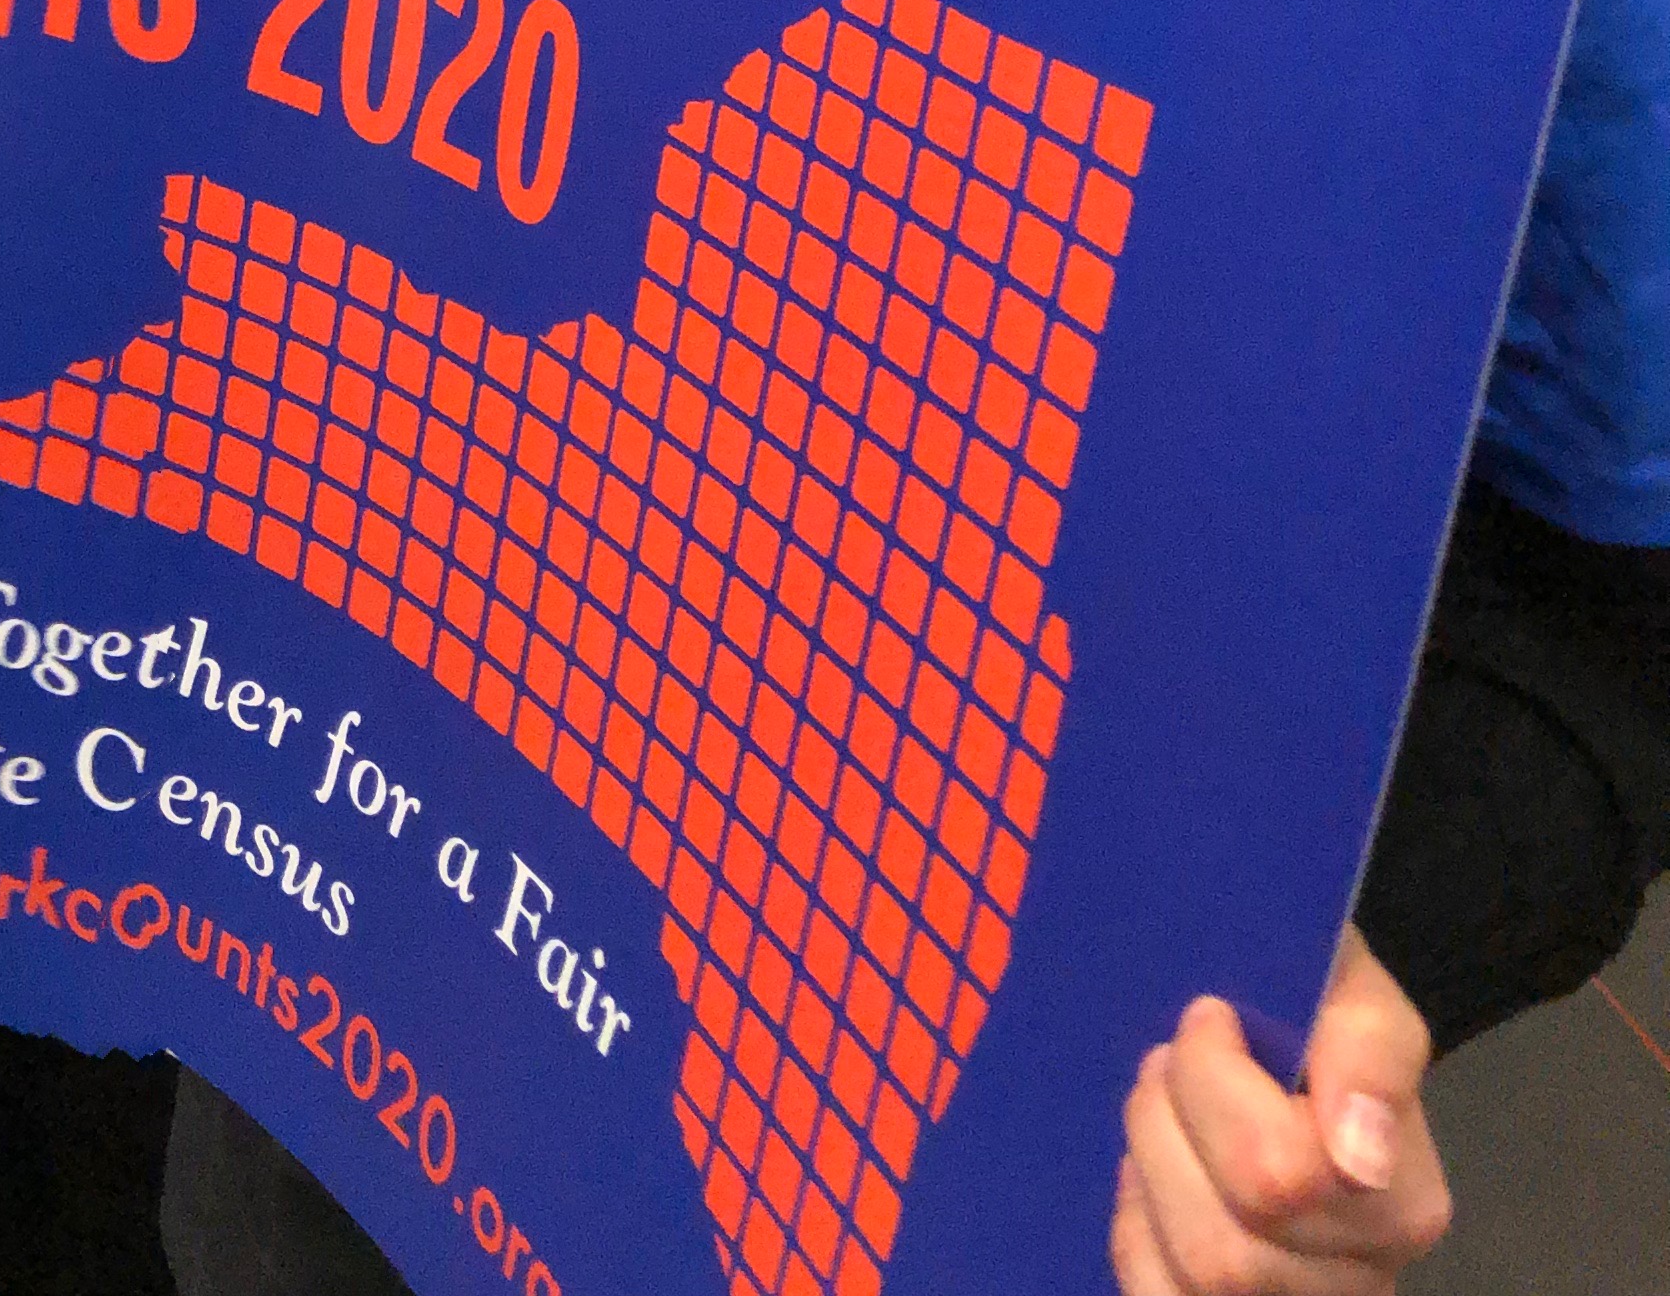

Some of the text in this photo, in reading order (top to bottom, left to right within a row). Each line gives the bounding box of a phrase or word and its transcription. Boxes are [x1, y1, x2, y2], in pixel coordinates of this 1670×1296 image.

[76, 726, 356, 936] Census
[314, 709, 422, 841] for
[438, 835, 476, 904] a
[494, 852, 633, 1059] Fair
